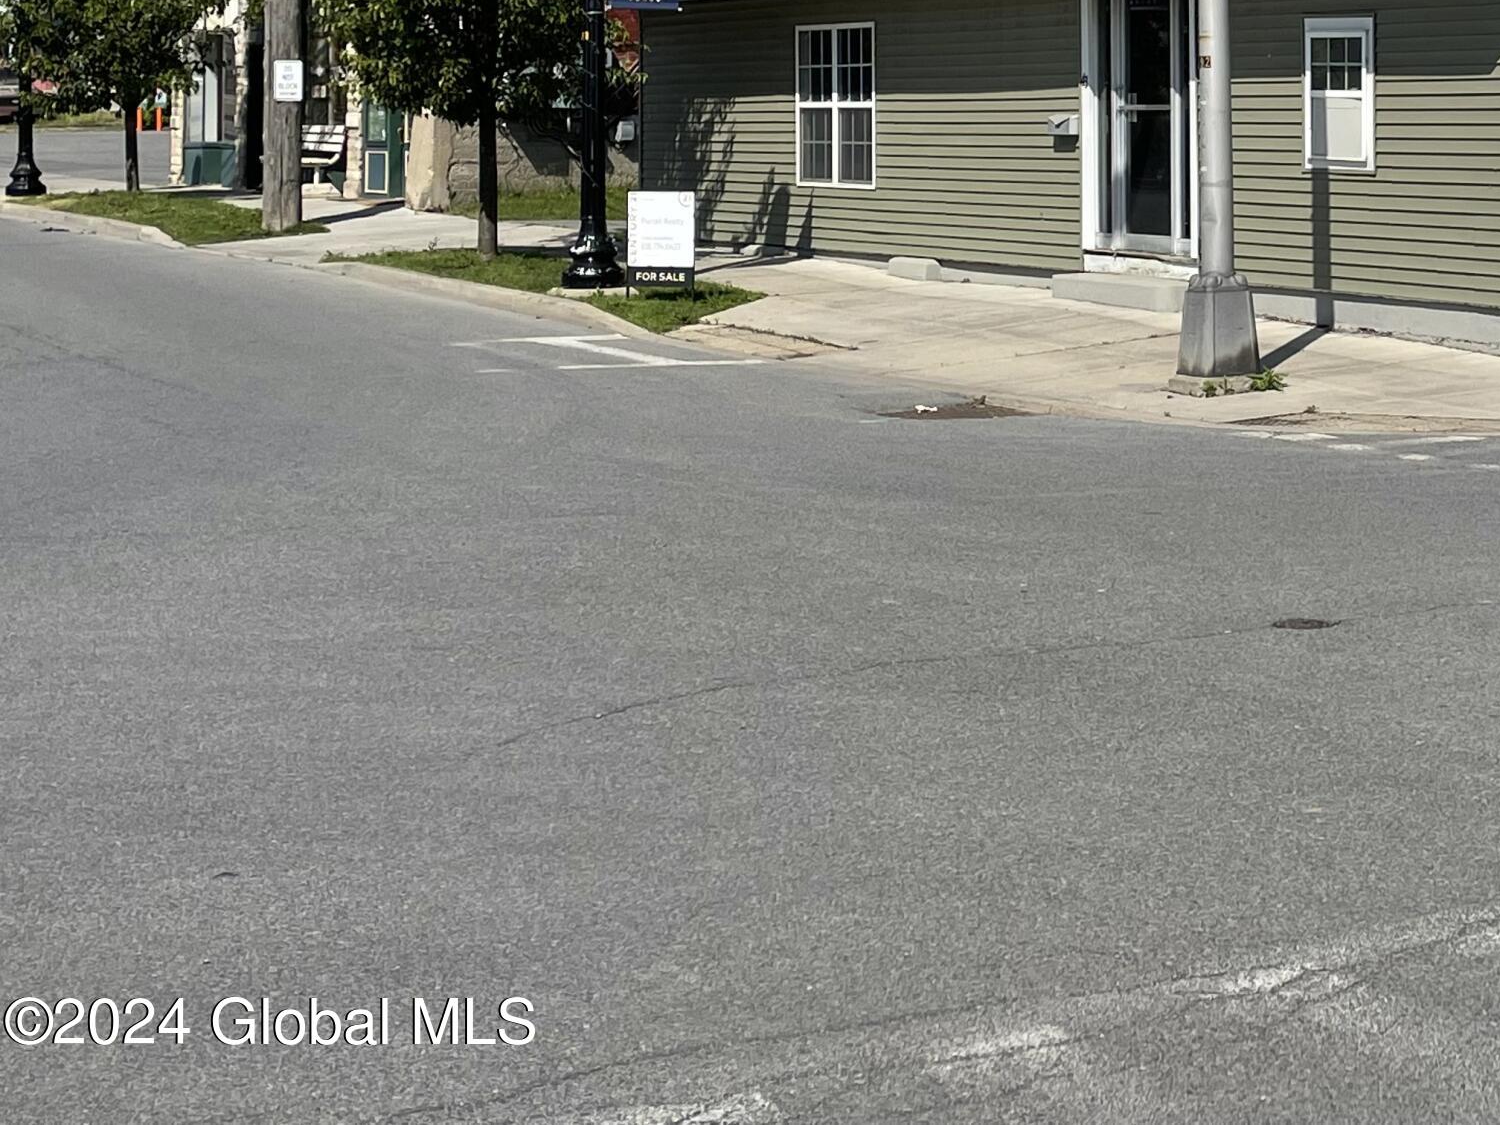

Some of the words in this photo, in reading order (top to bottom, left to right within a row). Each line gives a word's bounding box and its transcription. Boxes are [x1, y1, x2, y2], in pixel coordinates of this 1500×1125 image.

[629, 207, 638, 265] CENTURY
[635, 271, 657, 281] FOR
[658, 272, 686, 282] SALE
